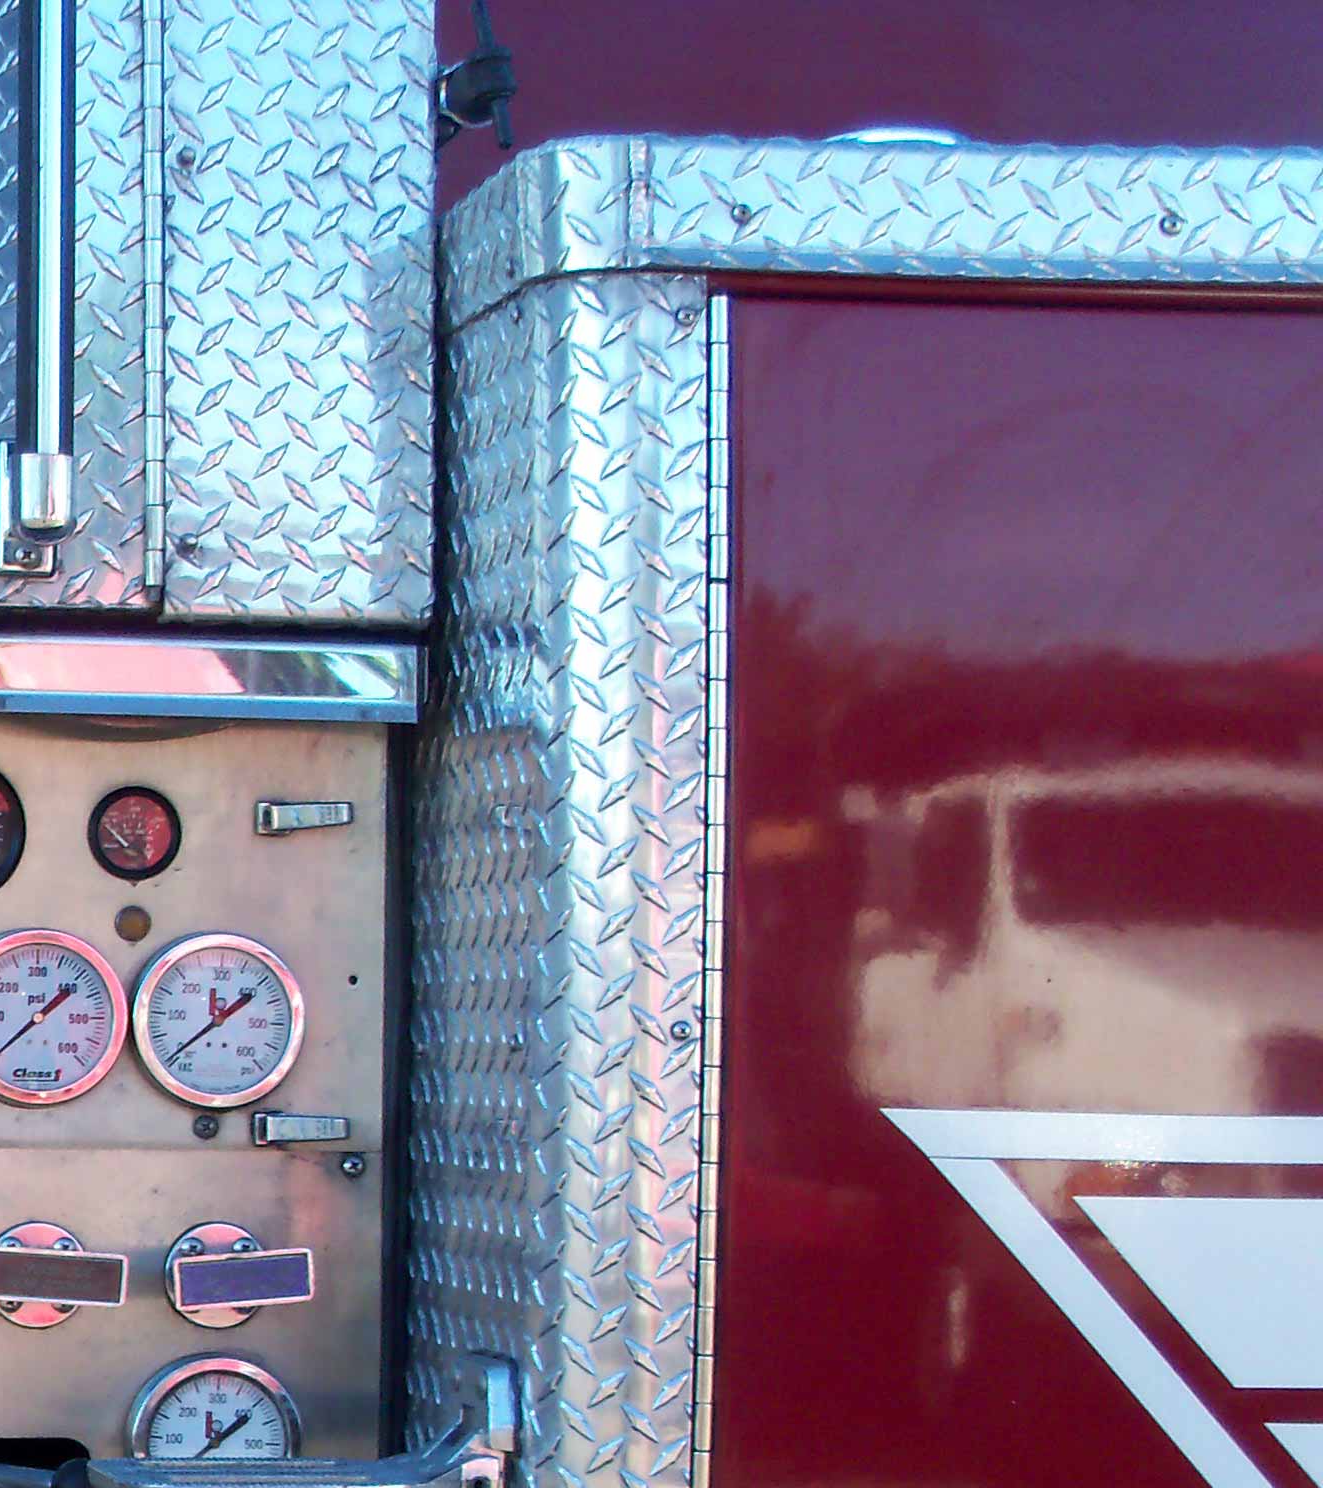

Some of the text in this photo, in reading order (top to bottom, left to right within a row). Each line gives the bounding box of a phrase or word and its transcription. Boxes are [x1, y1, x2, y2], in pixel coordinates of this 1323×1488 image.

[27, 966, 48, 978] 300
[27, 993, 46, 1006] psi
[68, 1013, 89, 1025] 500
[57, 1042, 78, 1054] 600
[208, 1393, 228, 1405] 300
[178, 1407, 198, 1418] 200
[165, 1433, 184, 1445] 100
[244, 1438, 263, 1450] 500
